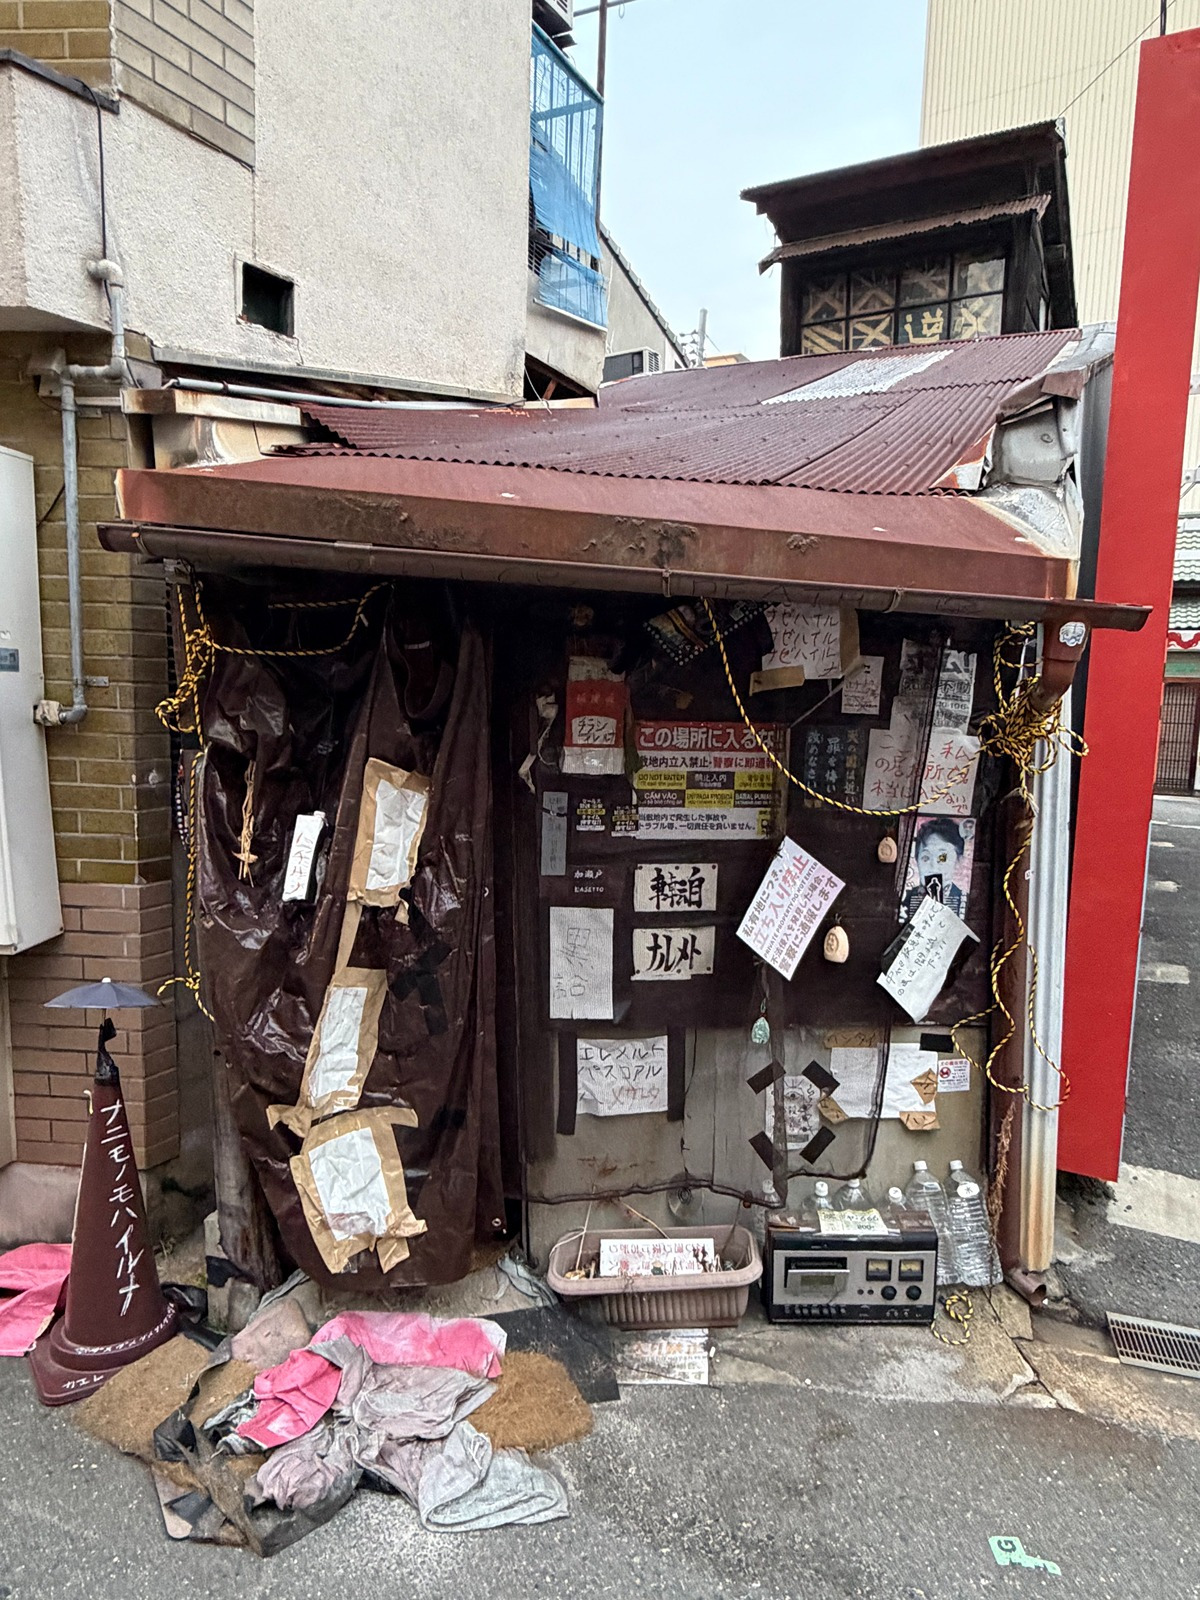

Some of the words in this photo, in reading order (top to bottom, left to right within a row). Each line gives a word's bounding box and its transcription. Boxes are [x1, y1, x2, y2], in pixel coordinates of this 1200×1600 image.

[750, 852, 811, 950] 立ち入り禁止
[762, 932, 779, 959] PRIVATE
[774, 902, 794, 933] PROPERTY
[803, 860, 819, 881] ENTER
[778, 875, 840, 974] 警察に通報します
[100, 1097, 146, 1317] ナニモノモハイルナ
